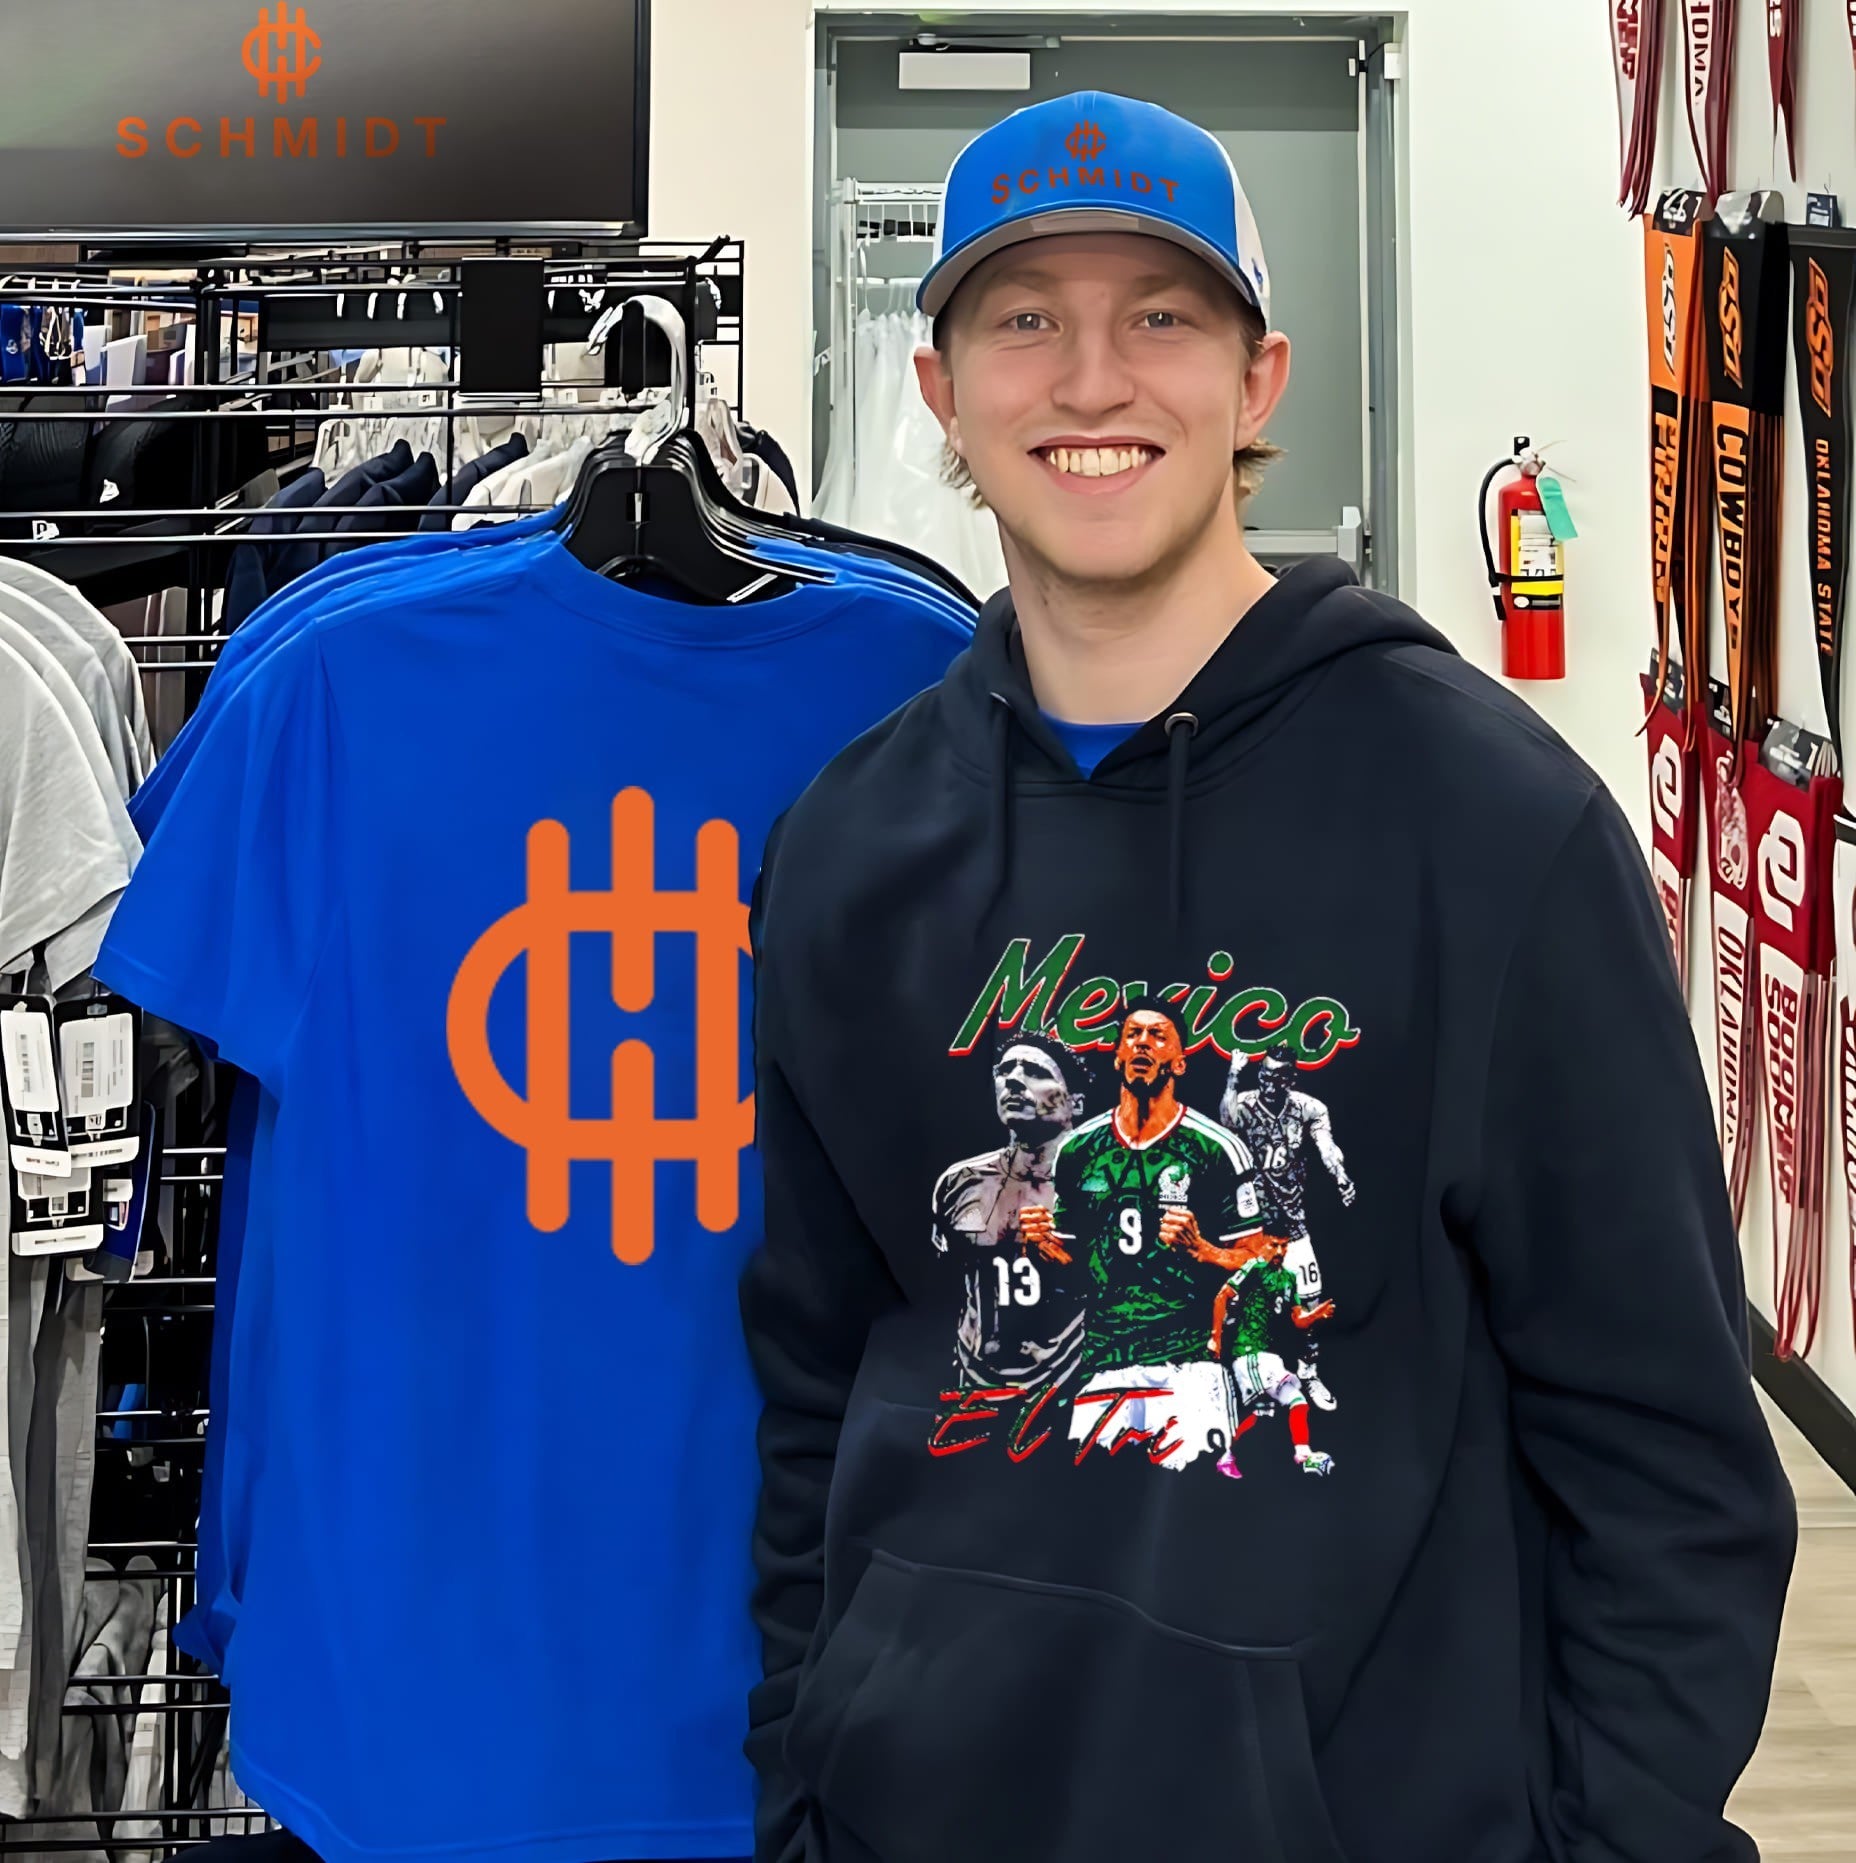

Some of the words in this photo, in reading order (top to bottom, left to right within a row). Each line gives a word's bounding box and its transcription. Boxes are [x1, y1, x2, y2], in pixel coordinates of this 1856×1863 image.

[116, 116, 449, 159] SCHMIDT
[991, 167, 1180, 205] SCHMIDT
[1815, 438, 1832, 570] OKLAHOMA
[1718, 926, 1745, 1144] OKLAHOMA
[1263, 1145, 1287, 1170] 16
[1118, 1208, 1144, 1256] 9
[994, 1256, 1041, 1307] 13
[1299, 1261, 1319, 1285] 16
